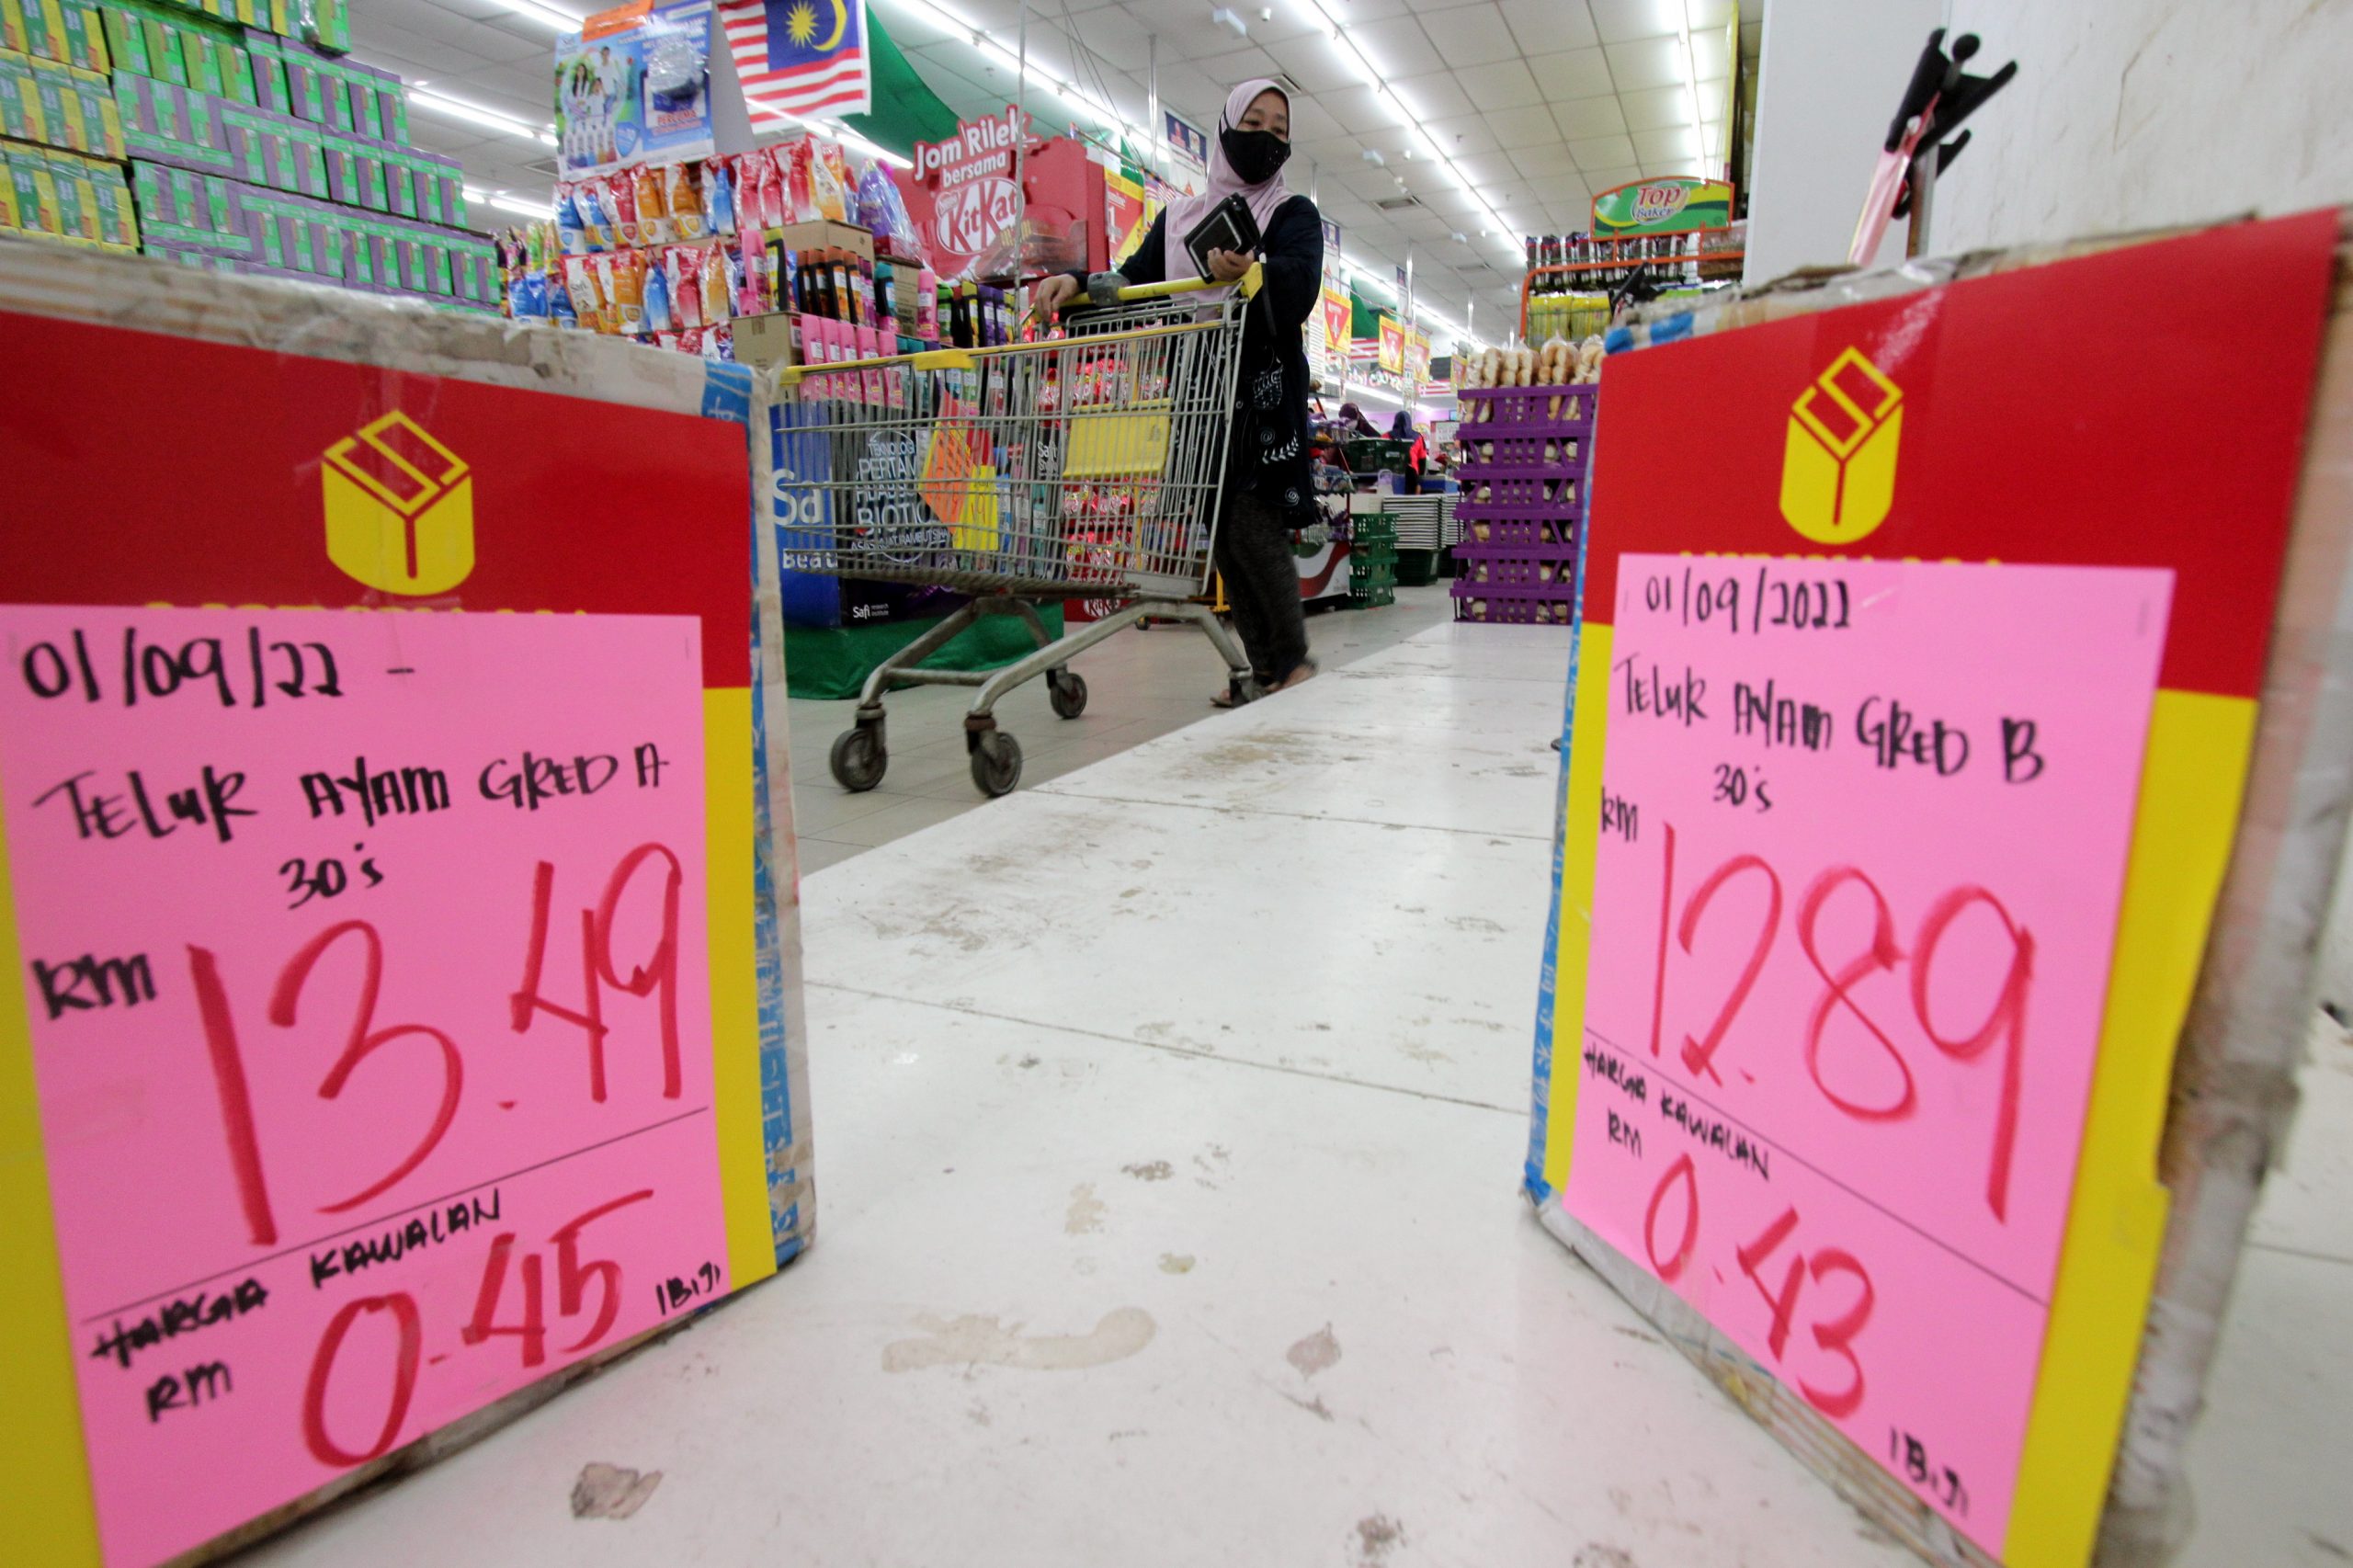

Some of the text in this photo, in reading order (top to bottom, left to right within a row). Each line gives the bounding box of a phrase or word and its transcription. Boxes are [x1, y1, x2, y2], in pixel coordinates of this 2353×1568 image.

[915, 107, 1027, 180] Jom Rilek
[942, 152, 1006, 187] bersama
[947, 180, 1017, 254] KitKat
[1637, 207, 1675, 220] Baker
[1639, 186, 1681, 208] Top
[1645, 567, 1851, 634] 01/09/2022
[22, 627, 344, 709] 01/09/22
[1855, 696, 1969, 777] GRED
[2001, 717, 2045, 782] B
[478, 752, 620, 811] GRED
[634, 743, 670, 788] A
[310, 1188, 501, 1289] KAWALAN
